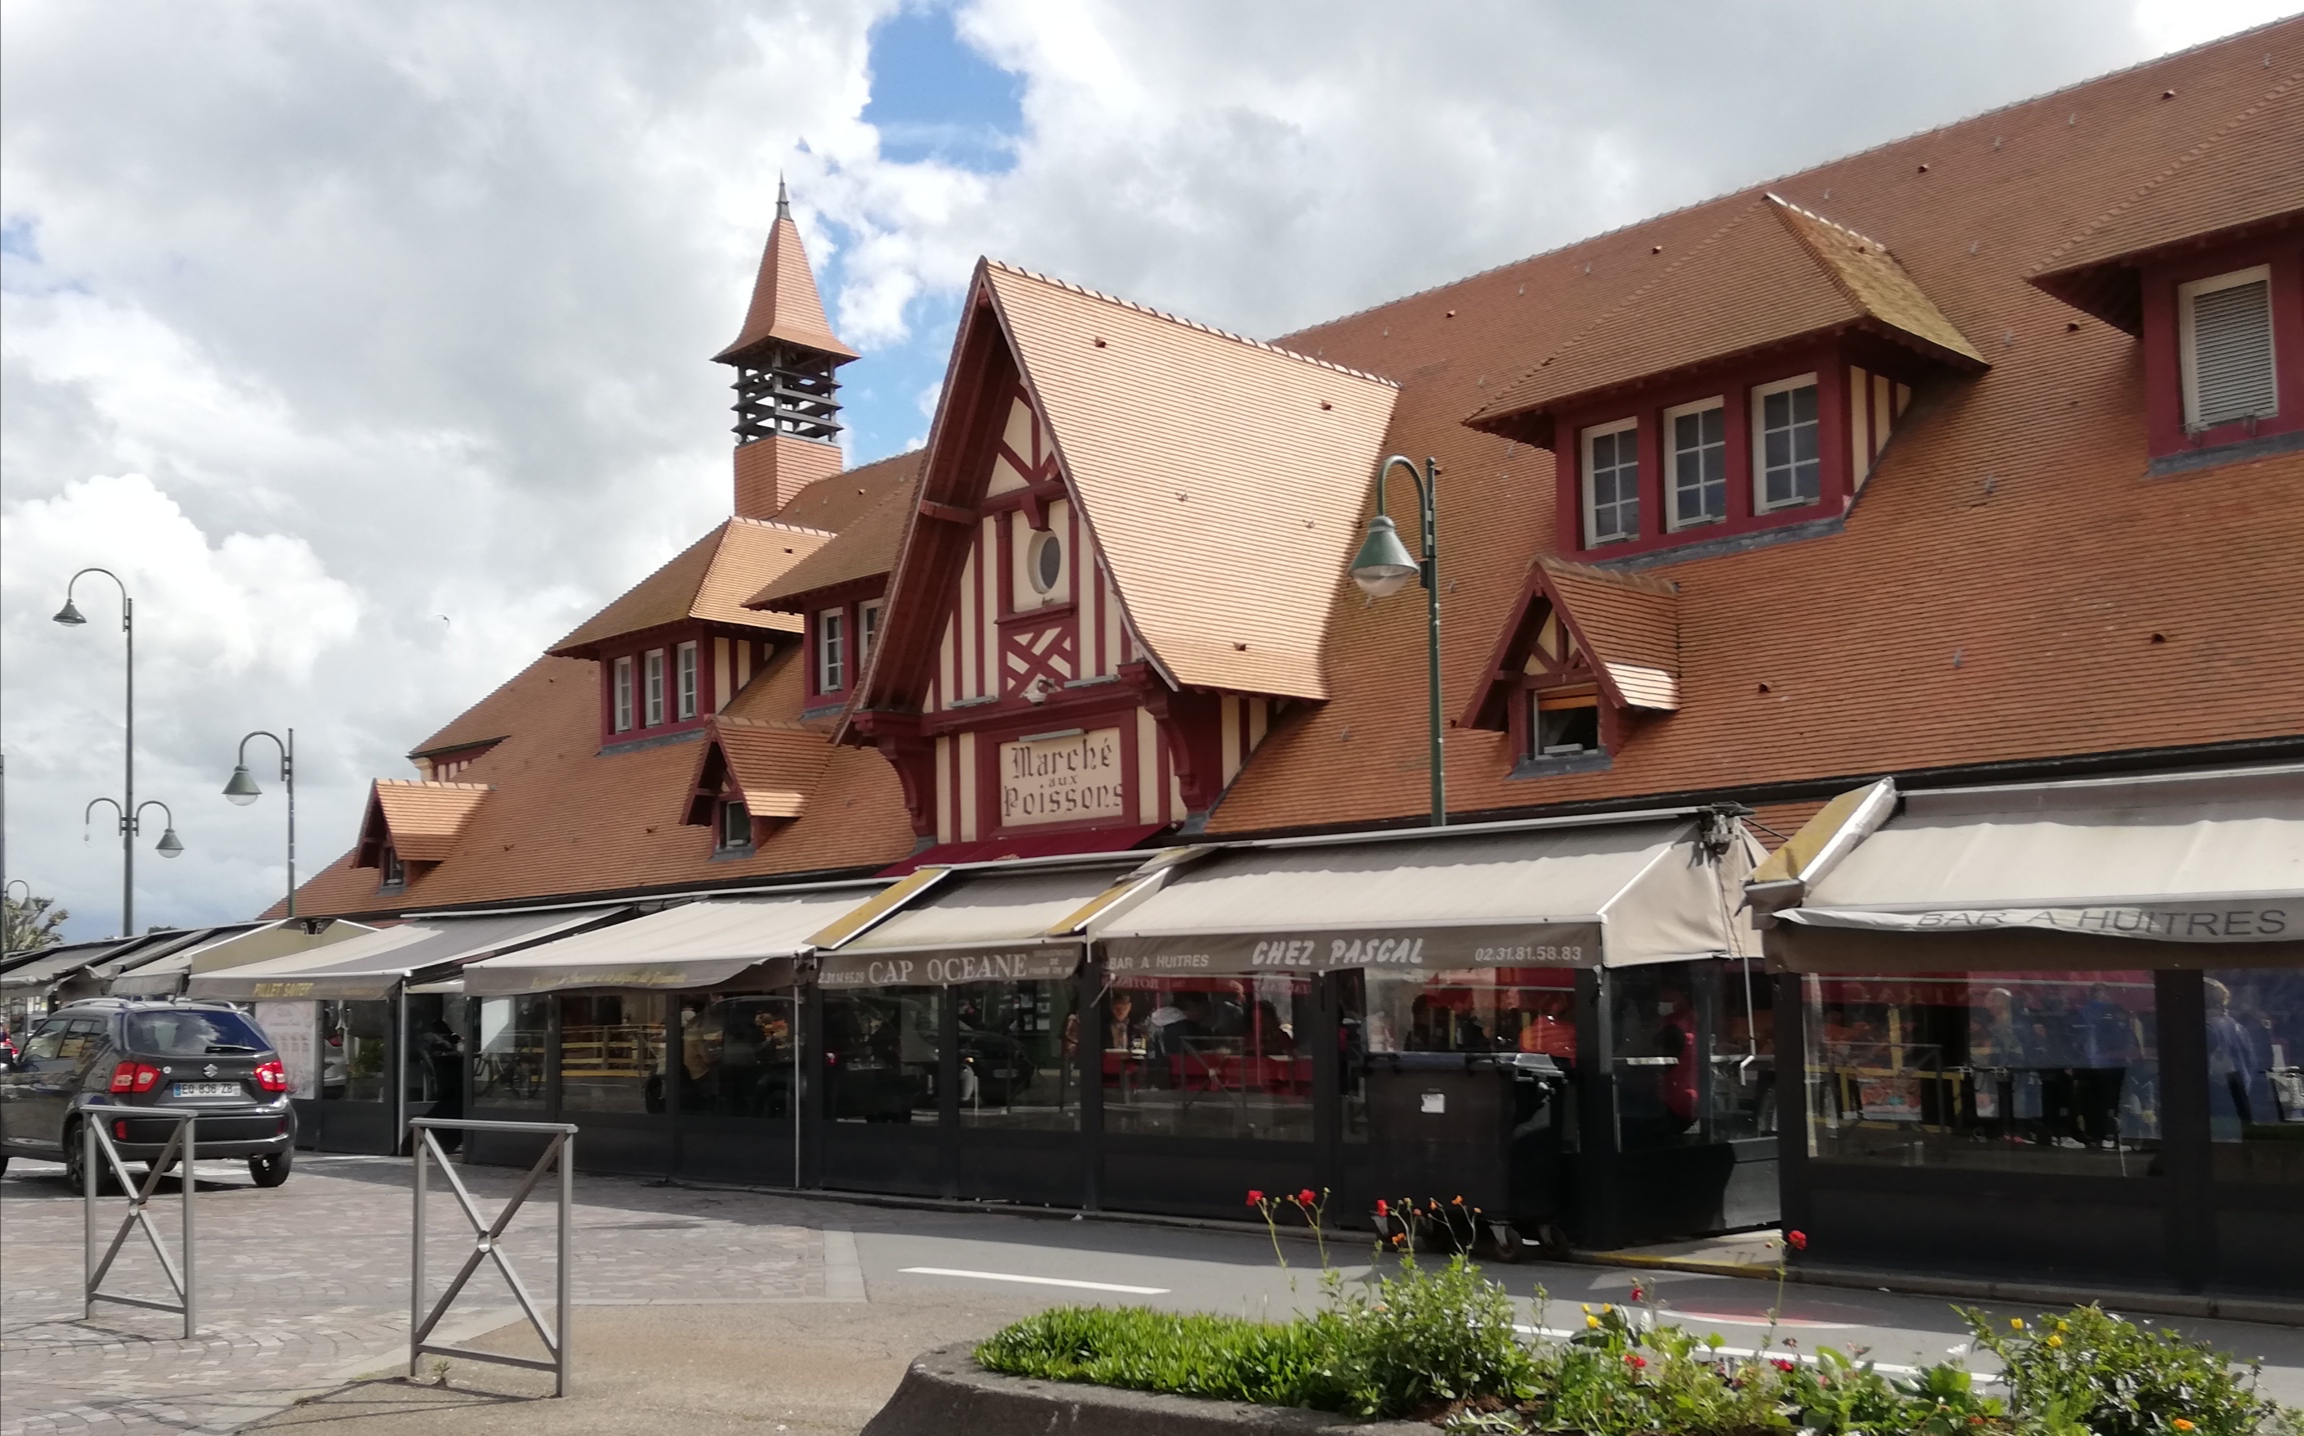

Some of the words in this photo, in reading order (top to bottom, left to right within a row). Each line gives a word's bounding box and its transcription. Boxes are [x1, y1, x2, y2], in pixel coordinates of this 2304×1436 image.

[1011, 738, 1112, 779] Marché
[1048, 774, 1078, 788] aux
[1004, 783, 1123, 817] Poissons
[1916, 910, 2005, 927] BAR
[2026, 910, 2058, 926] A
[2077, 909, 2287, 936] HUITRES
[1109, 957, 1133, 970] BAR
[1140, 956, 1150, 969] A
[1156, 954, 1210, 968] HUITRES
[1252, 940, 1315, 965] CHEZ
[1329, 938, 1424, 965] PASCAL
[1475, 946, 1582, 961] 02.31.81.58.83
[868, 960, 914, 985] CAP
[927, 954, 1027, 982] OCEANE
